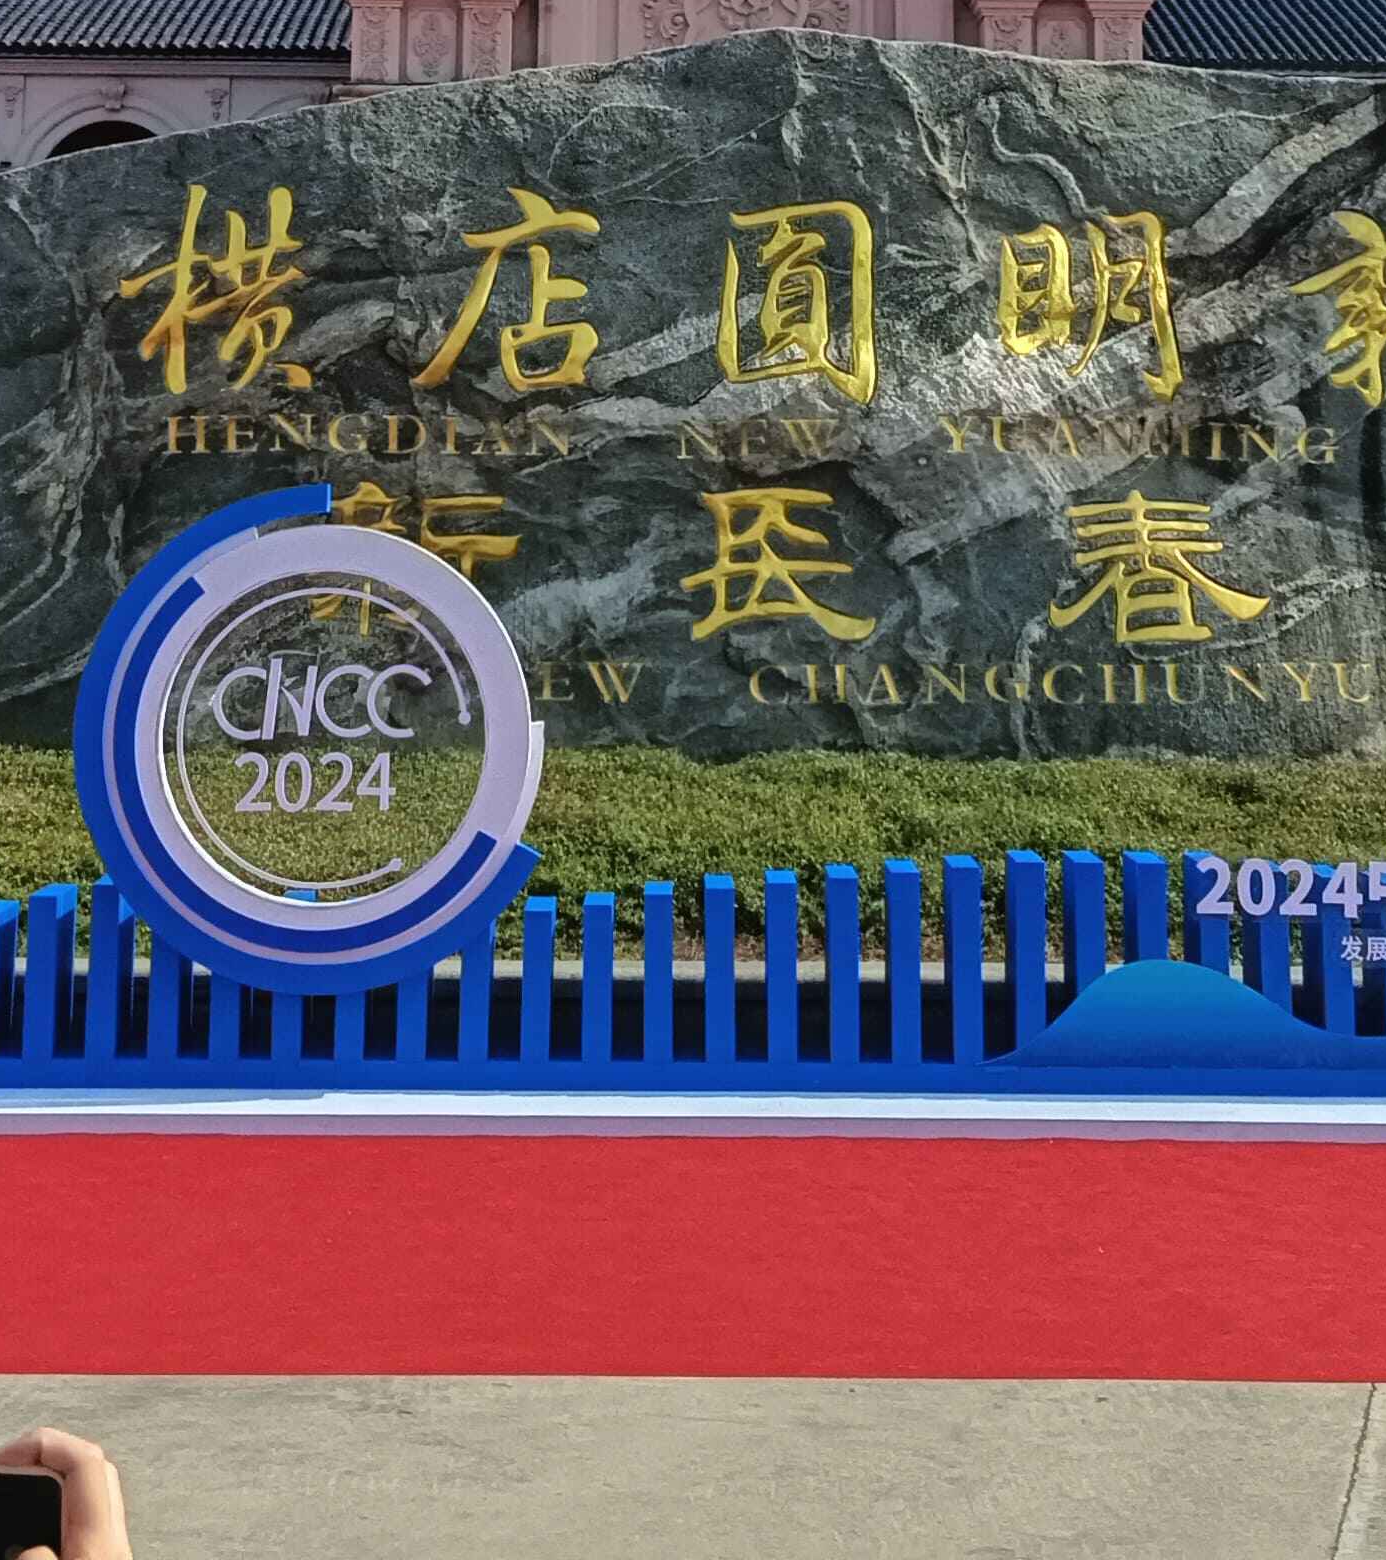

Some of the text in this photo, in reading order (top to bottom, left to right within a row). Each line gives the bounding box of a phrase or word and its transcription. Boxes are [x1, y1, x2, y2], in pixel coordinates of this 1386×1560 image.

[166, 414, 573, 456] HENGDIAN
[676, 417, 840, 460] NEW
[212, 657, 433, 741] CNCC
[532, 660, 644, 704] EW
[234, 751, 397, 813] 2024
